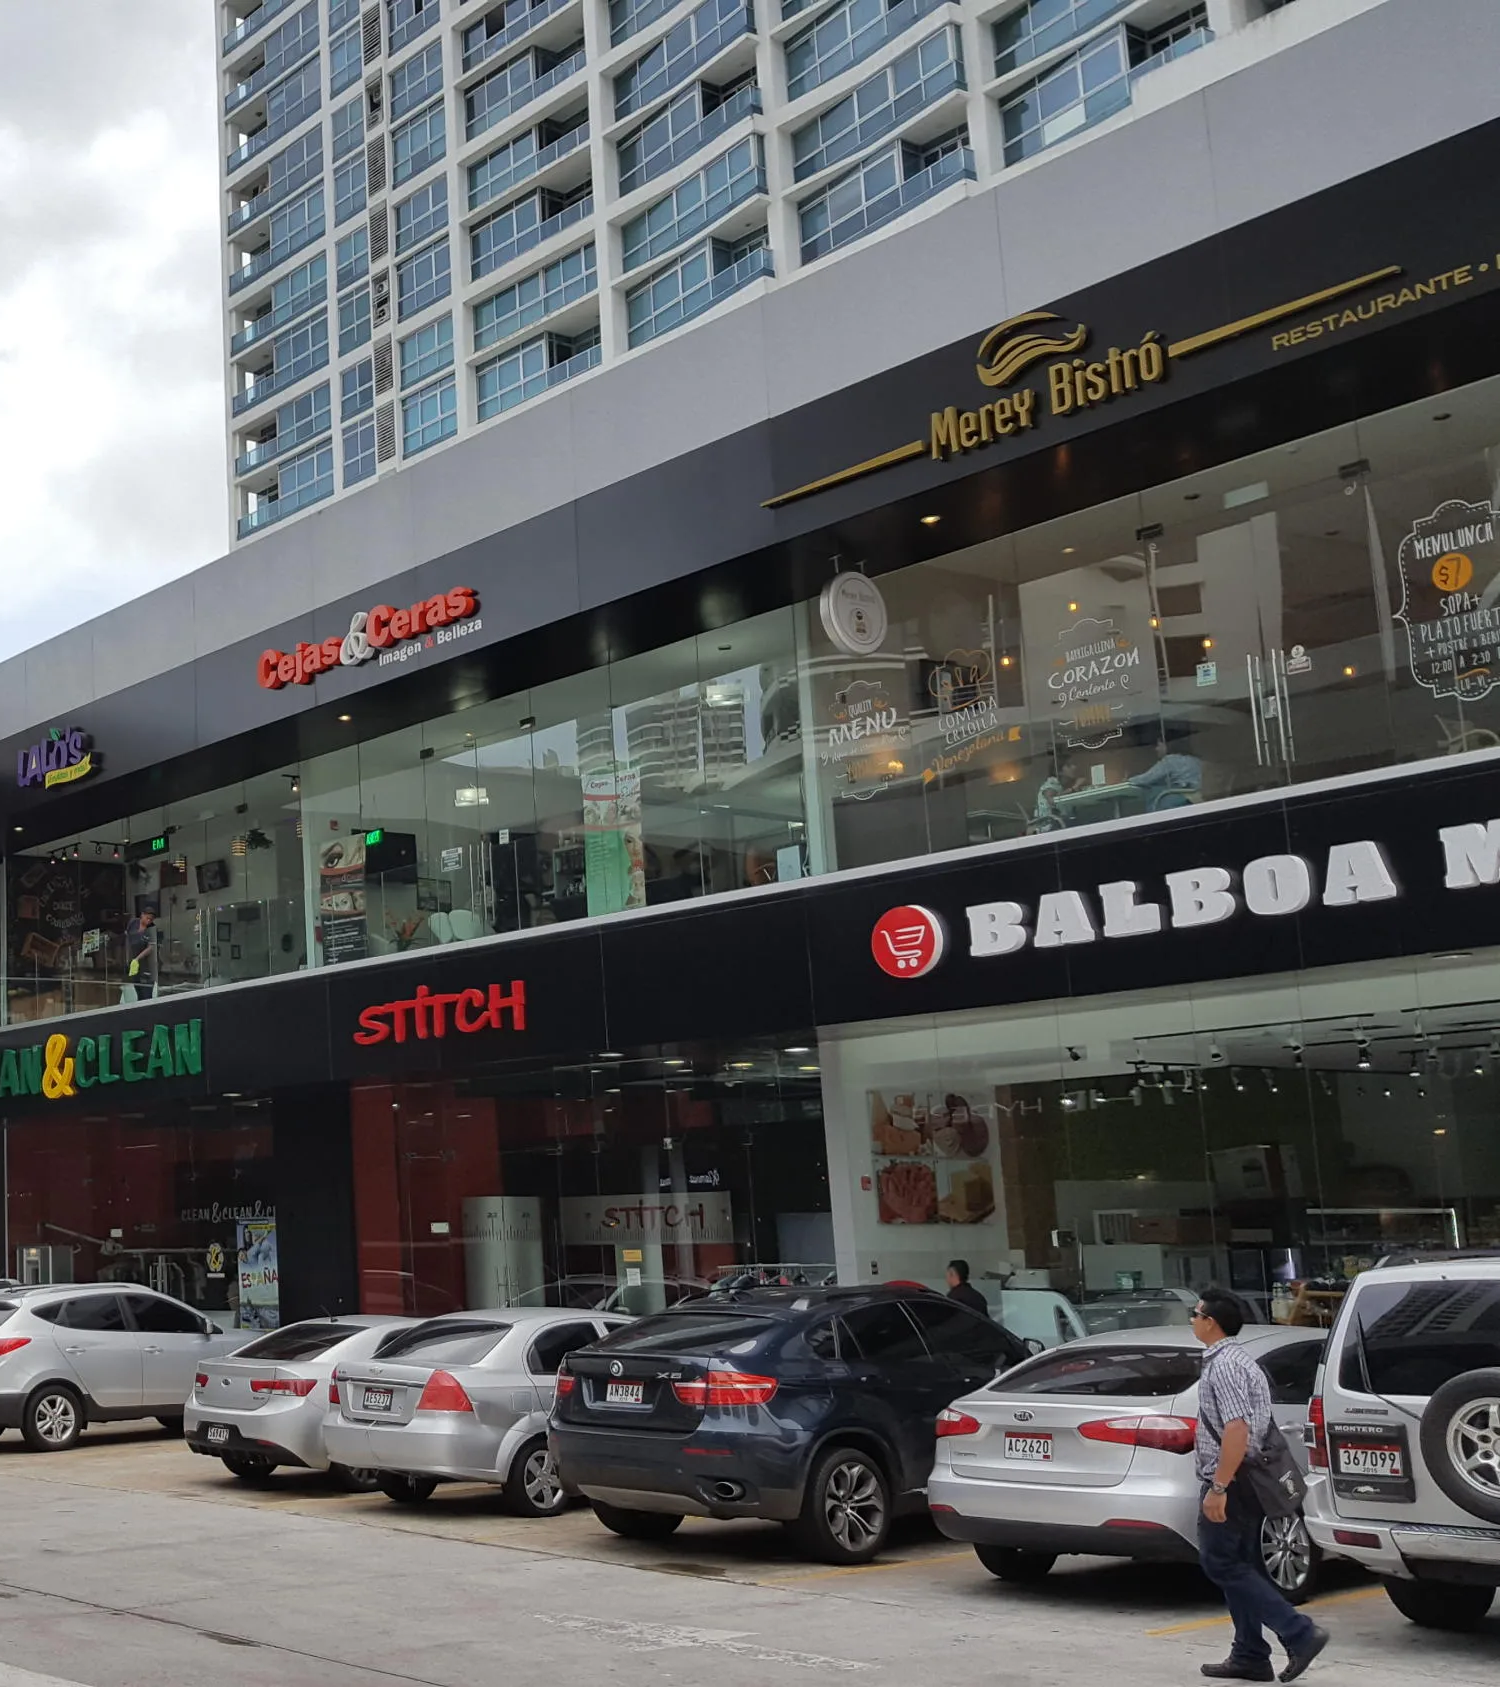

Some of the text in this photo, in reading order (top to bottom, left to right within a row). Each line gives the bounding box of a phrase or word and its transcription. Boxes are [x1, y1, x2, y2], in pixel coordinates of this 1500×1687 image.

[1271, 265, 1474, 351] RESTAURANTE
[931, 330, 1165, 461] Merey Bistró
[1438, 556, 1462, 588] $7
[379, 641, 422, 667] Imagen
[436, 618, 483, 645] Belleza
[1420, 616, 1461, 643] PLATO
[1048, 646, 1141, 689] CORAZON
[829, 707, 898, 748] MENU
[938, 695, 998, 732] COMIDA
[965, 840, 1399, 958] BALBOA
[1007, 1438, 1049, 1454] AC2620
[1334, 1425, 1384, 1433] MONTERO
[1343, 1449, 1397, 1470] 367099
